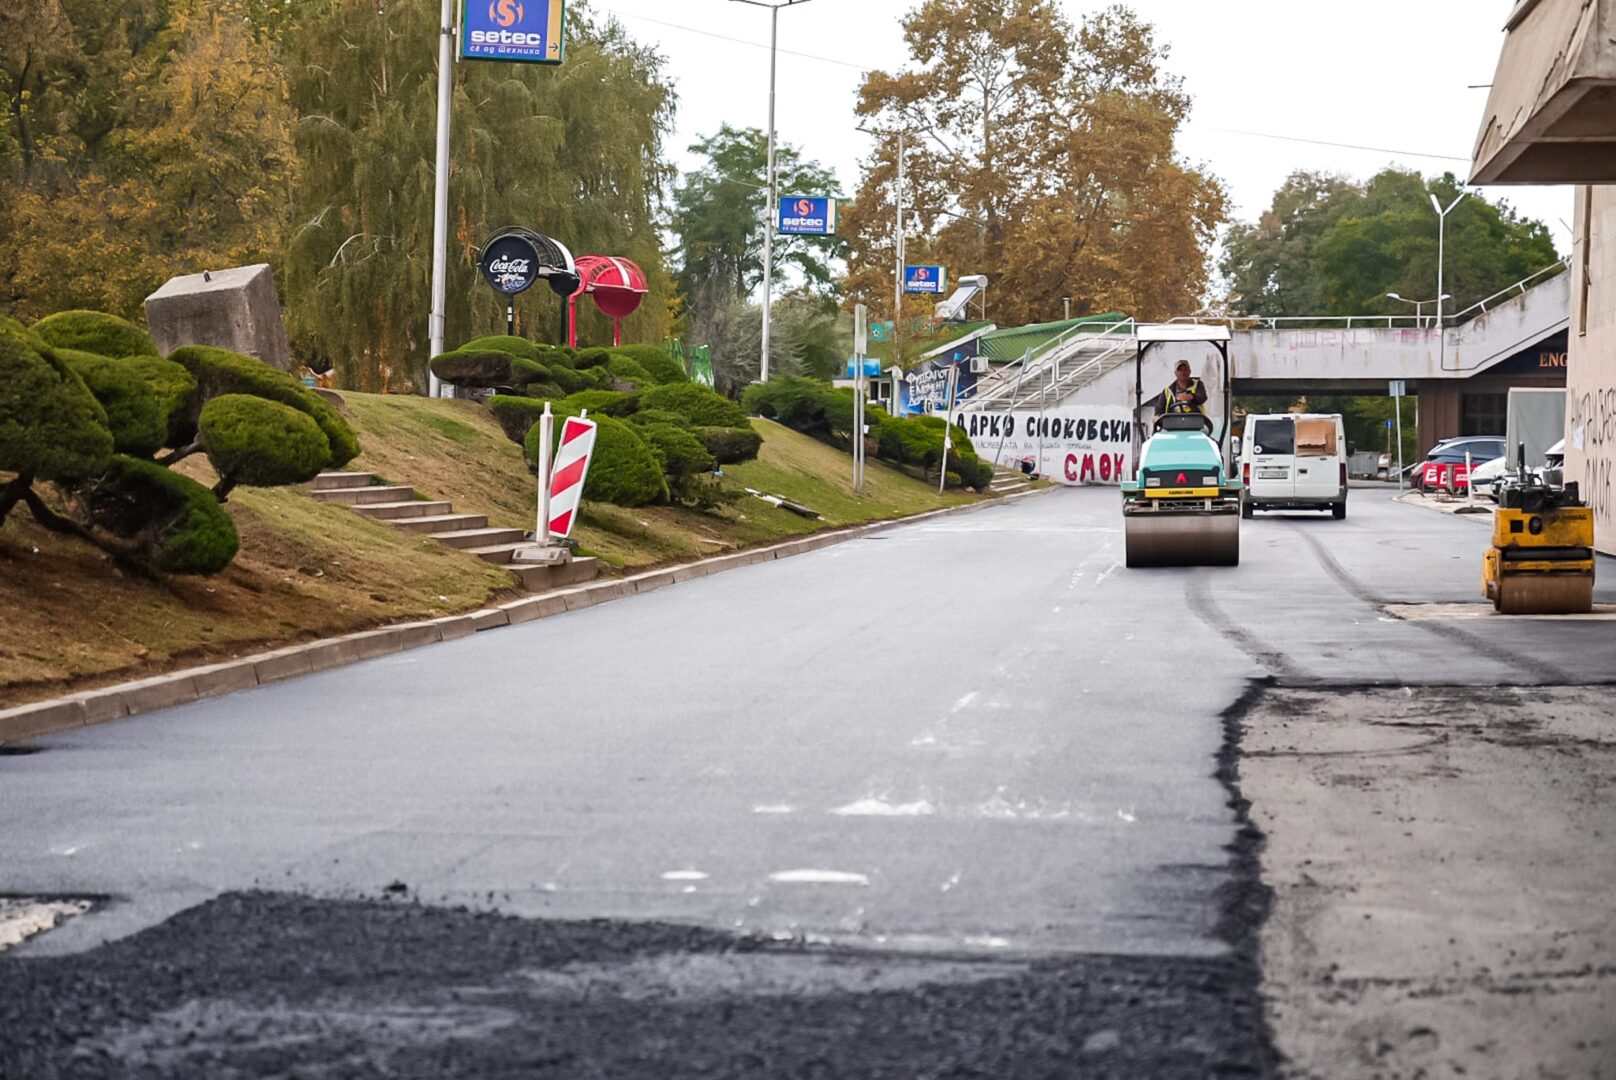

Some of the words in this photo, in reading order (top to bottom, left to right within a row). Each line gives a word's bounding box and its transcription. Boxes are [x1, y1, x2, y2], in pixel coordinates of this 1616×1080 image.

[471, 29, 541, 45] setec
[782, 217, 824, 226] setec
[957, 413, 1015, 437] ДАРКО
[1026, 416, 1132, 443] СМОКОВСКИ
[1063, 453, 1125, 482] СМОК
